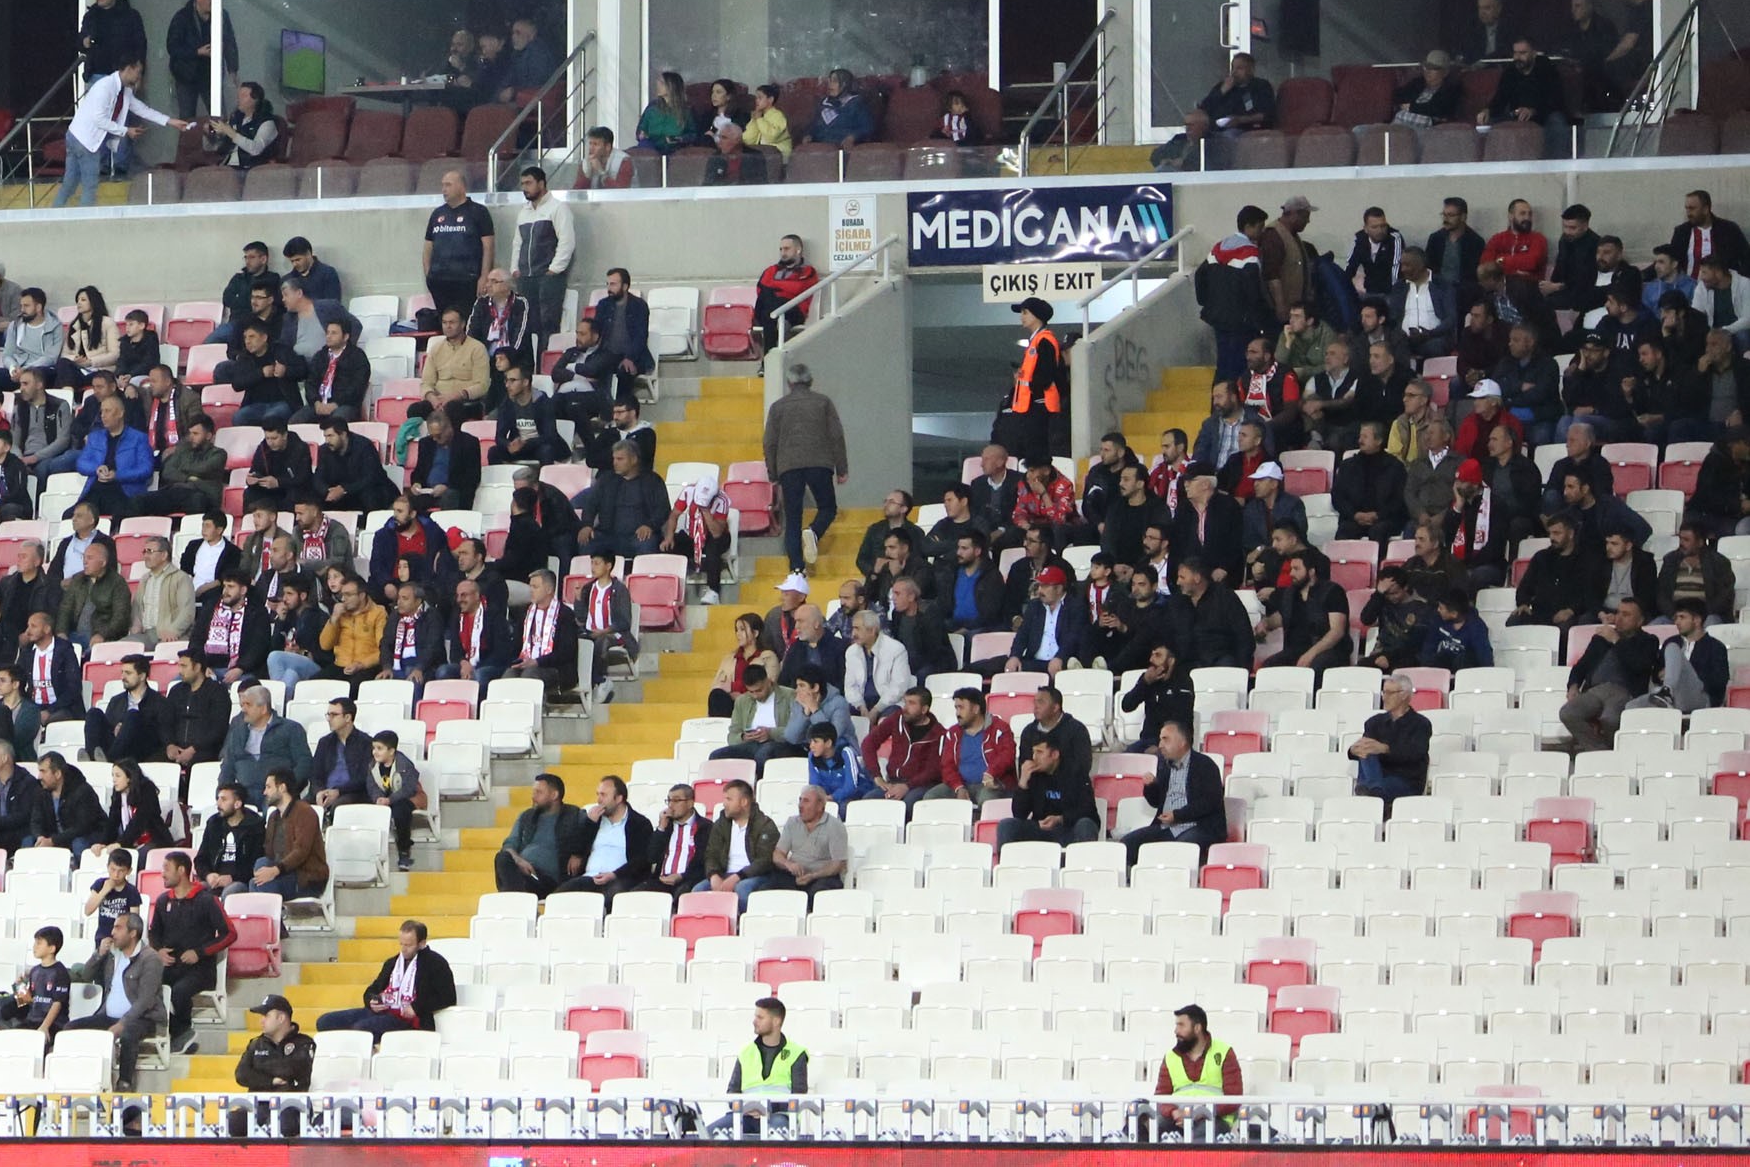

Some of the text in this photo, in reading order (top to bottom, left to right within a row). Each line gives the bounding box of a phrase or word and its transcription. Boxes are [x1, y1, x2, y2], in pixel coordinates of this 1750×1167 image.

[912, 205, 1141, 250] MEDICANA
[990, 274, 1038, 296] ÇIKIŞ
[1054, 273, 1095, 290] EXIT
